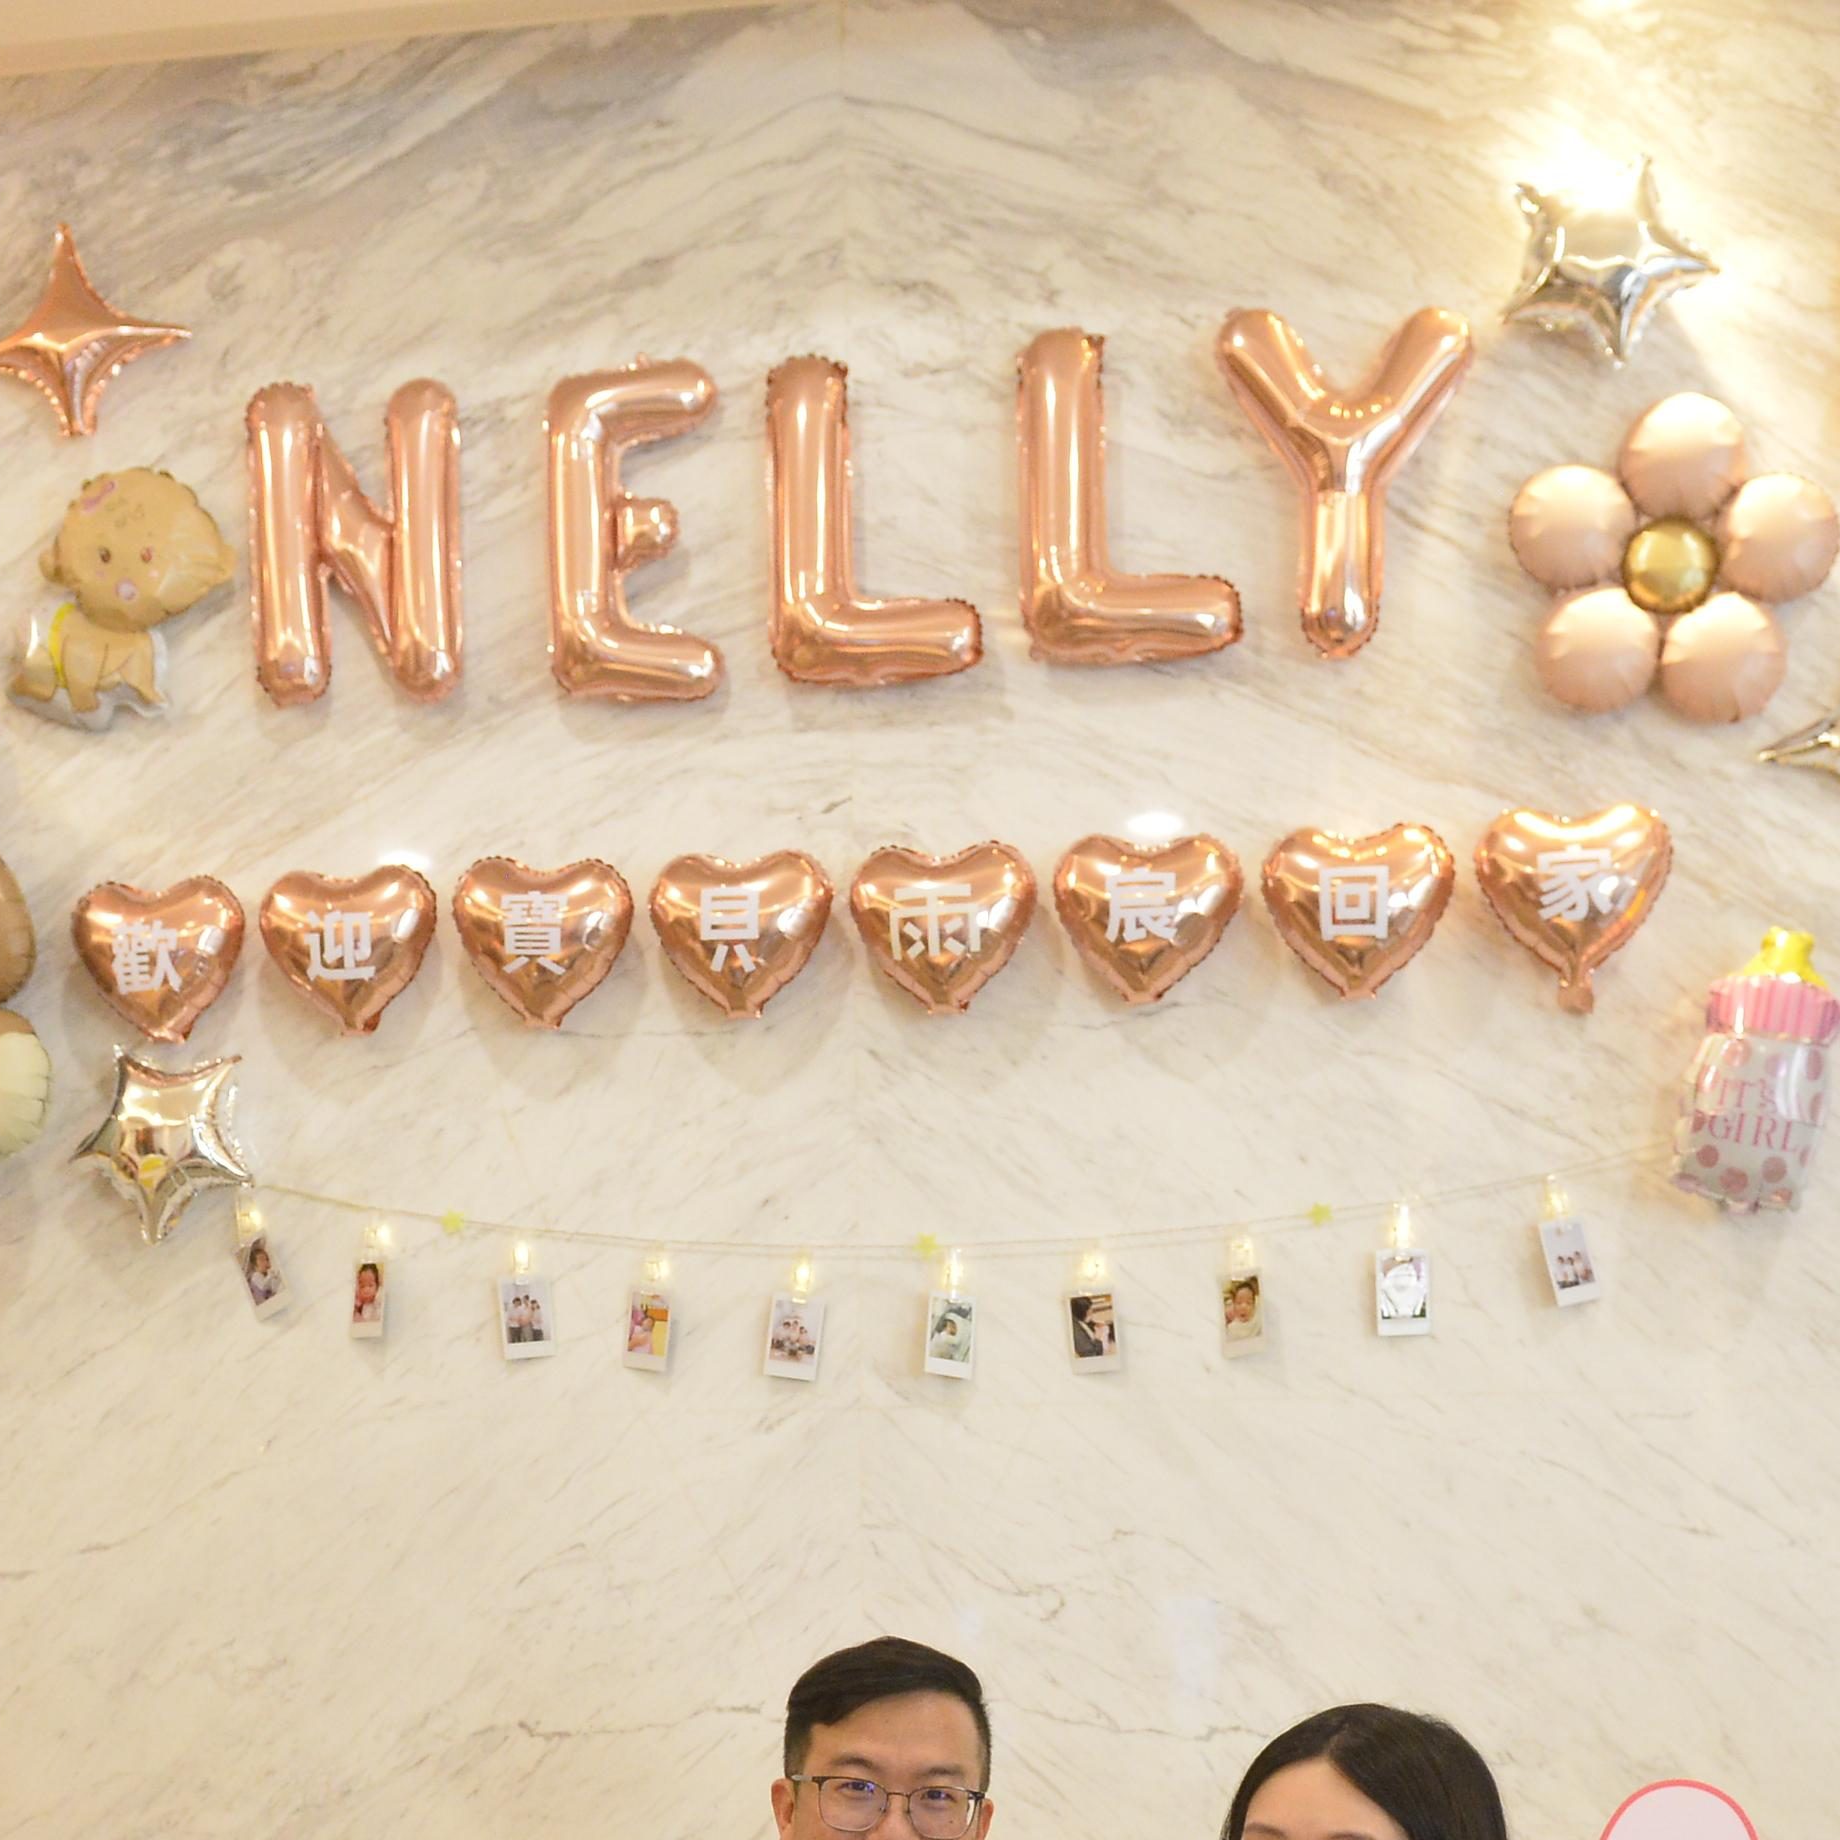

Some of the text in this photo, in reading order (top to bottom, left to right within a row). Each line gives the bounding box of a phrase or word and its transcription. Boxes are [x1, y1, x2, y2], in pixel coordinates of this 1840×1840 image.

[244, 305, 1473, 706] NELLY
[108, 845, 1620, 997] 歡迎寶貝雨宸回家
